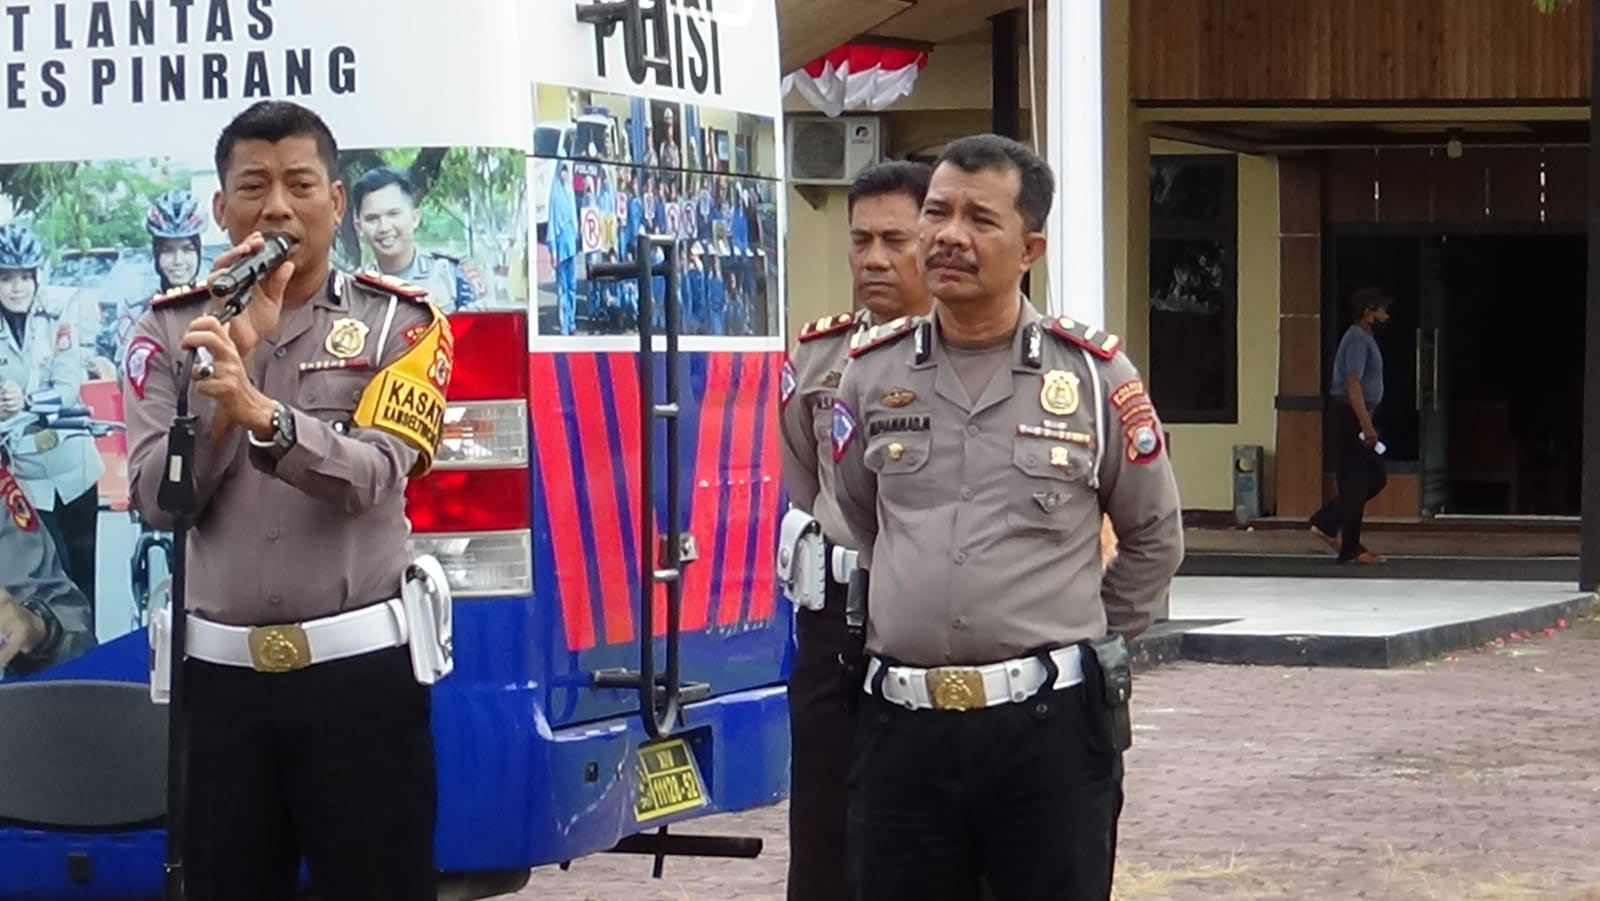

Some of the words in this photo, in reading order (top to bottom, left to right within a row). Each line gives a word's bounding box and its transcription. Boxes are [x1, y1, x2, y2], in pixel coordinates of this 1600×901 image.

[54, 0, 275, 50] LANTAS
[91, 45, 357, 105] PINRANG
[388, 379, 443, 430] KASAT
